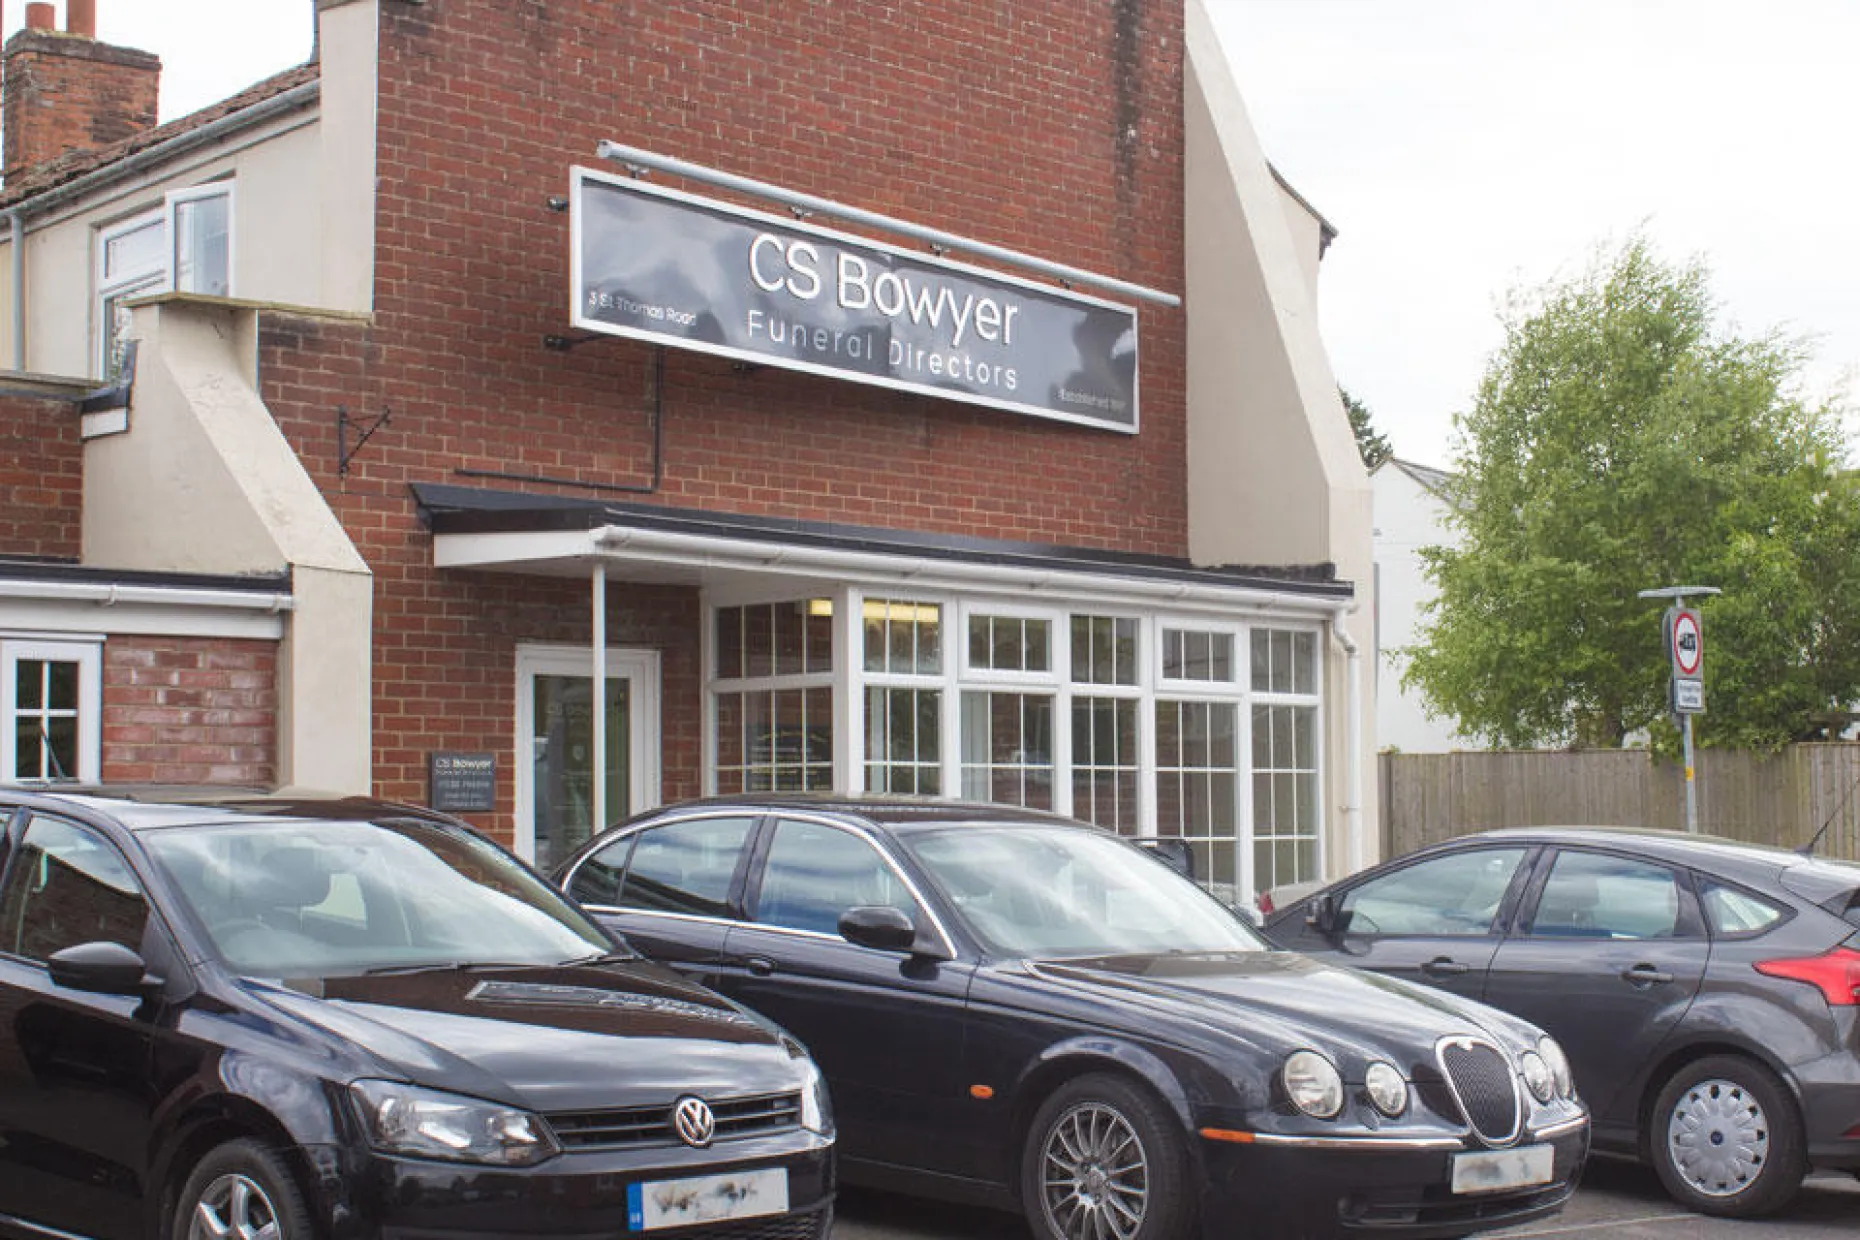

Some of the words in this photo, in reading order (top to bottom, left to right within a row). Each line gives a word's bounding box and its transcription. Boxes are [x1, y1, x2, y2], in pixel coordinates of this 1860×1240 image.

[750, 232, 821, 300] CS
[837, 251, 1019, 348] Bowyer
[747, 309, 872, 361] Funeral
[889, 337, 1017, 390] Directors
